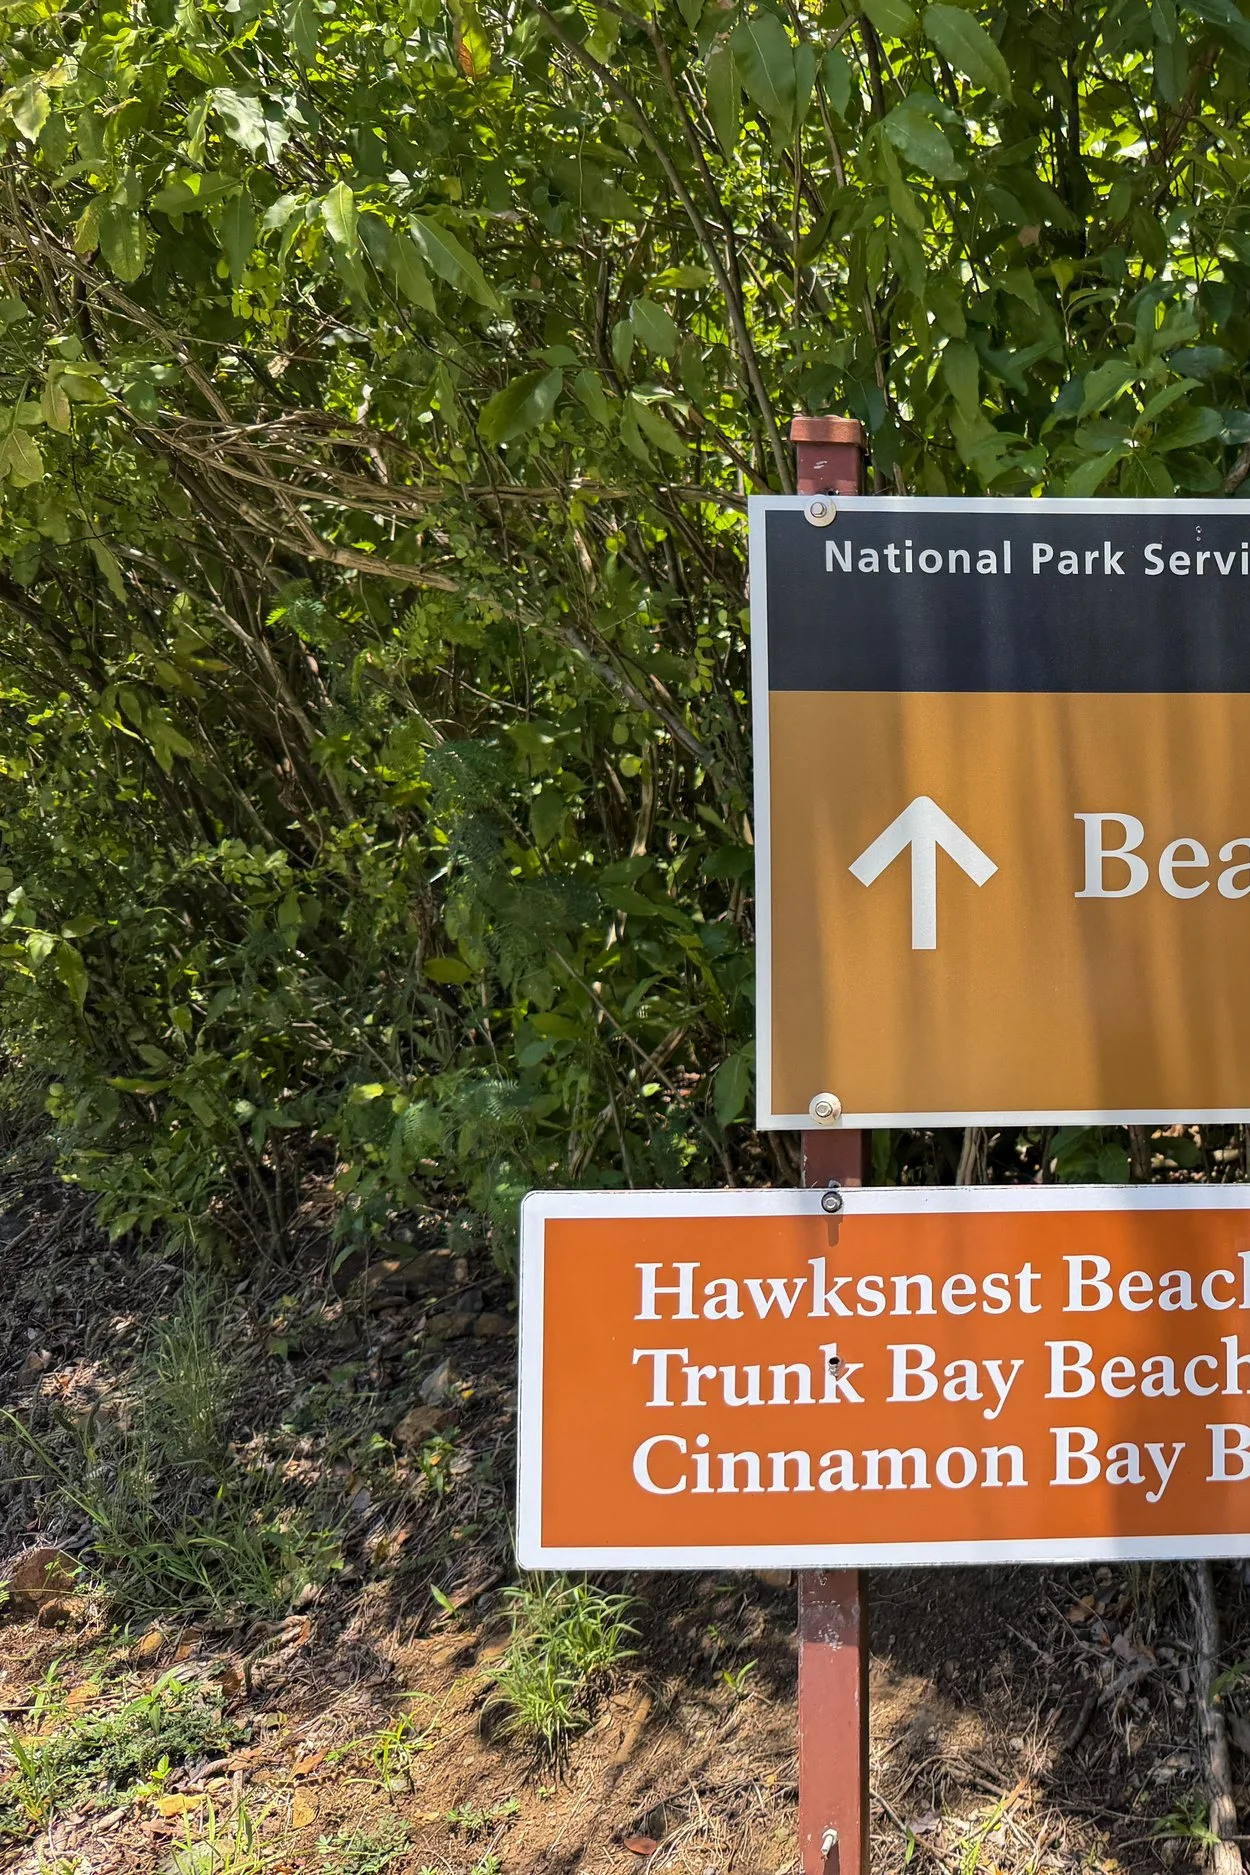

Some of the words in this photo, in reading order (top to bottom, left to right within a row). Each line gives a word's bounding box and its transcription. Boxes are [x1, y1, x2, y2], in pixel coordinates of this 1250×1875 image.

[825, 540, 1012, 575] National
[1032, 541, 1126, 575] Park
[634, 1256, 1042, 1321] Hawksnest
[632, 1343, 866, 1407] Trunk
[885, 1343, 1025, 1420] Bay
[632, 1433, 1029, 1495] Cinnamon
[1049, 1426, 1187, 1503] Bay
